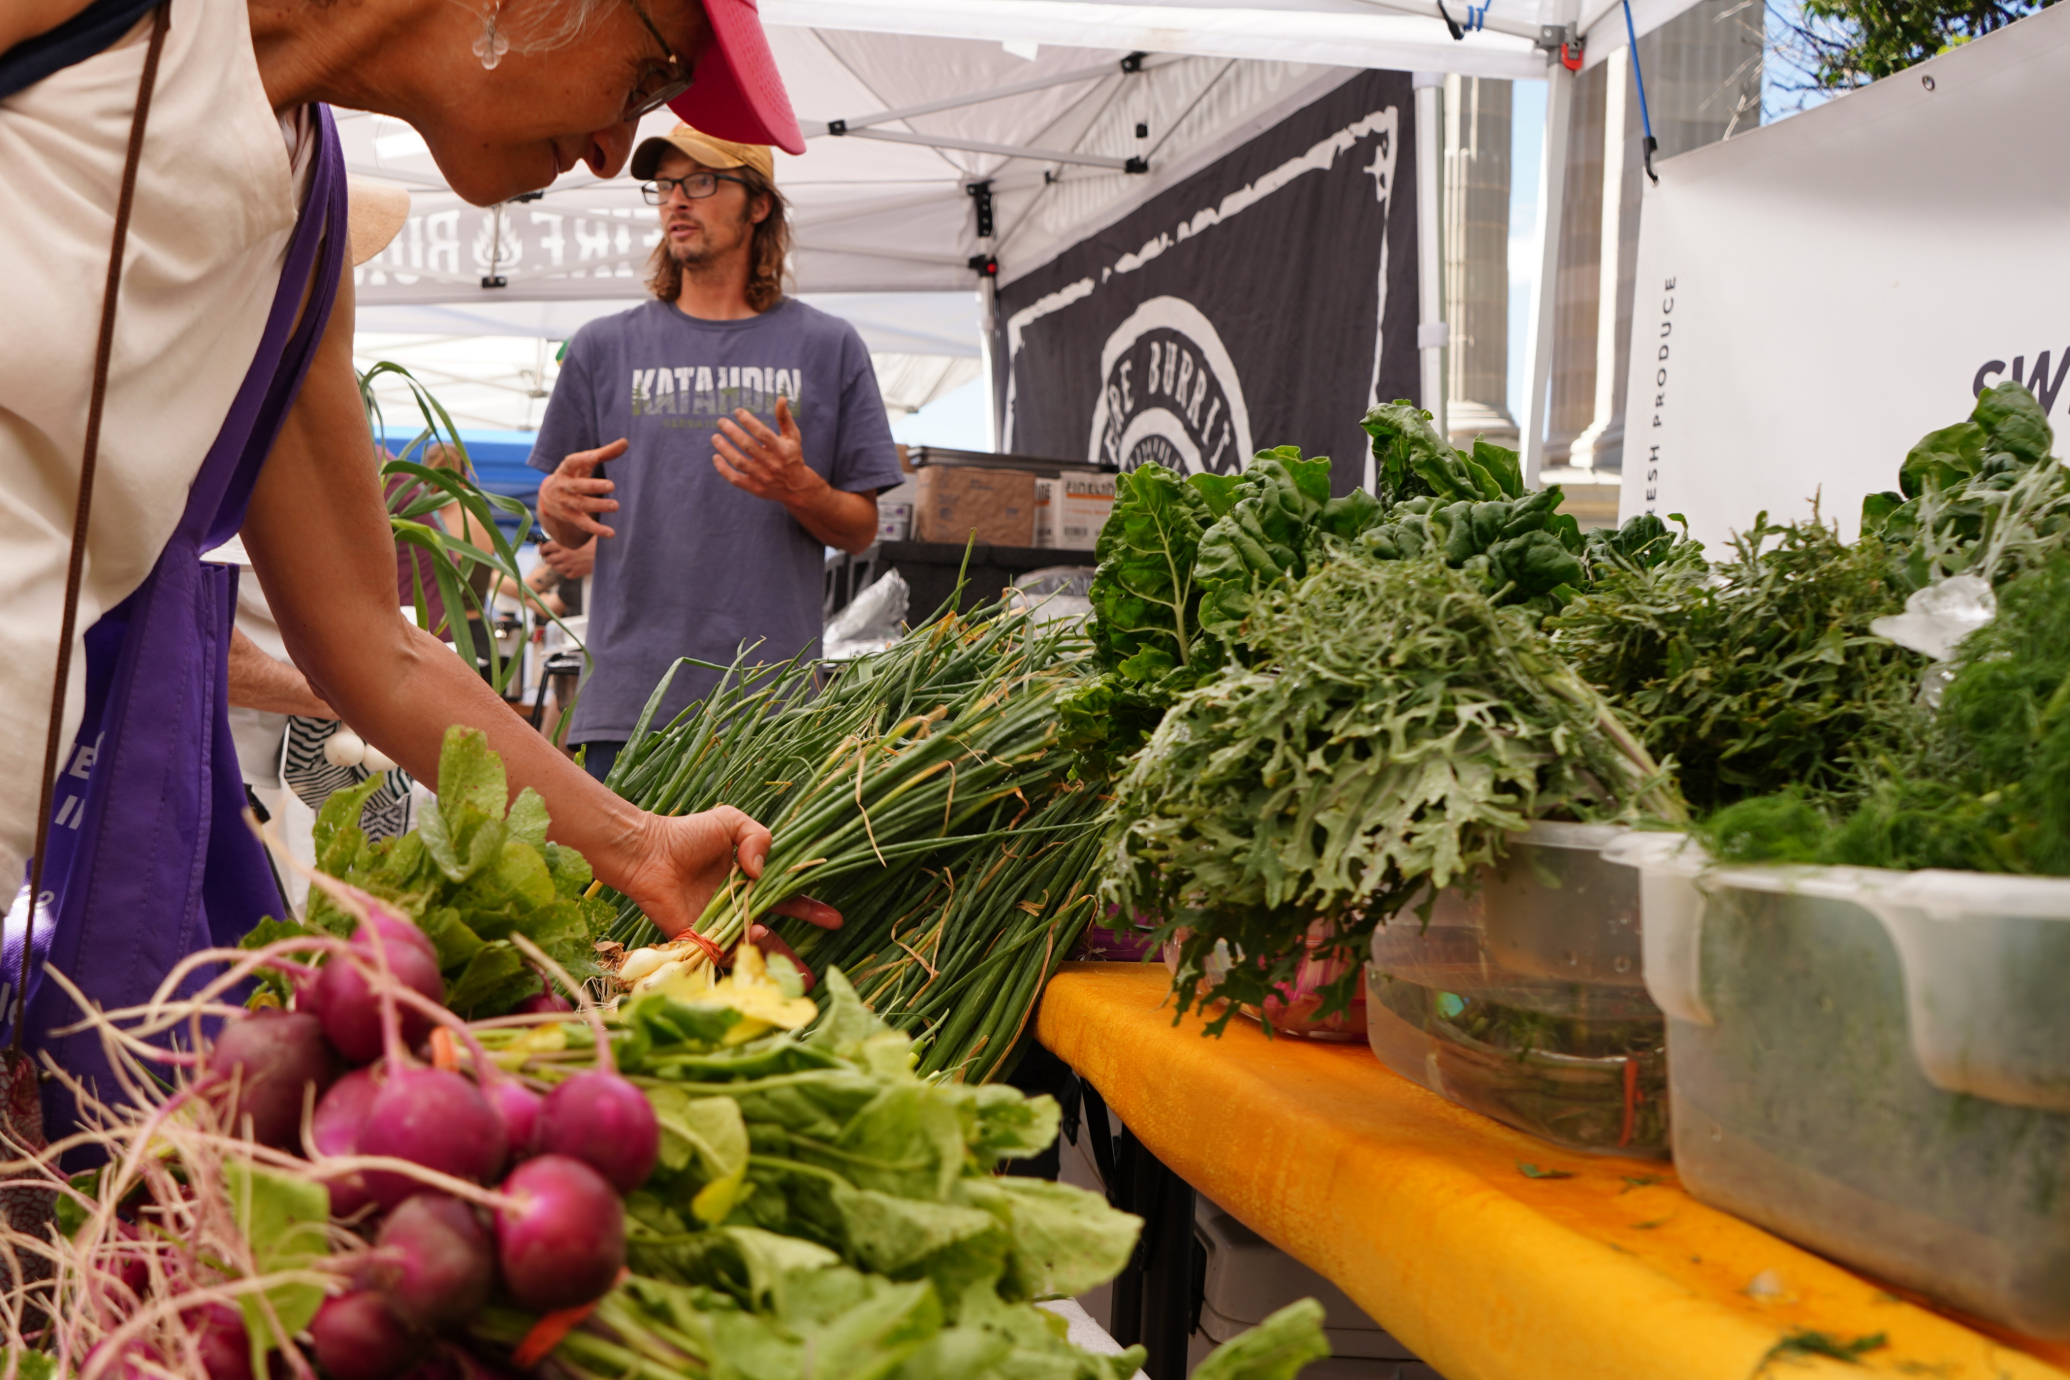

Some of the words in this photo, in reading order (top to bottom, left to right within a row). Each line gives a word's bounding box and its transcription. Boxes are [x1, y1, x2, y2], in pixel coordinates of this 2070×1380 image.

[632, 366, 802, 416] KATAHDIN
[1148, 341, 1238, 476] BURRIT
[1652, 275, 1676, 428] PRODUCE
